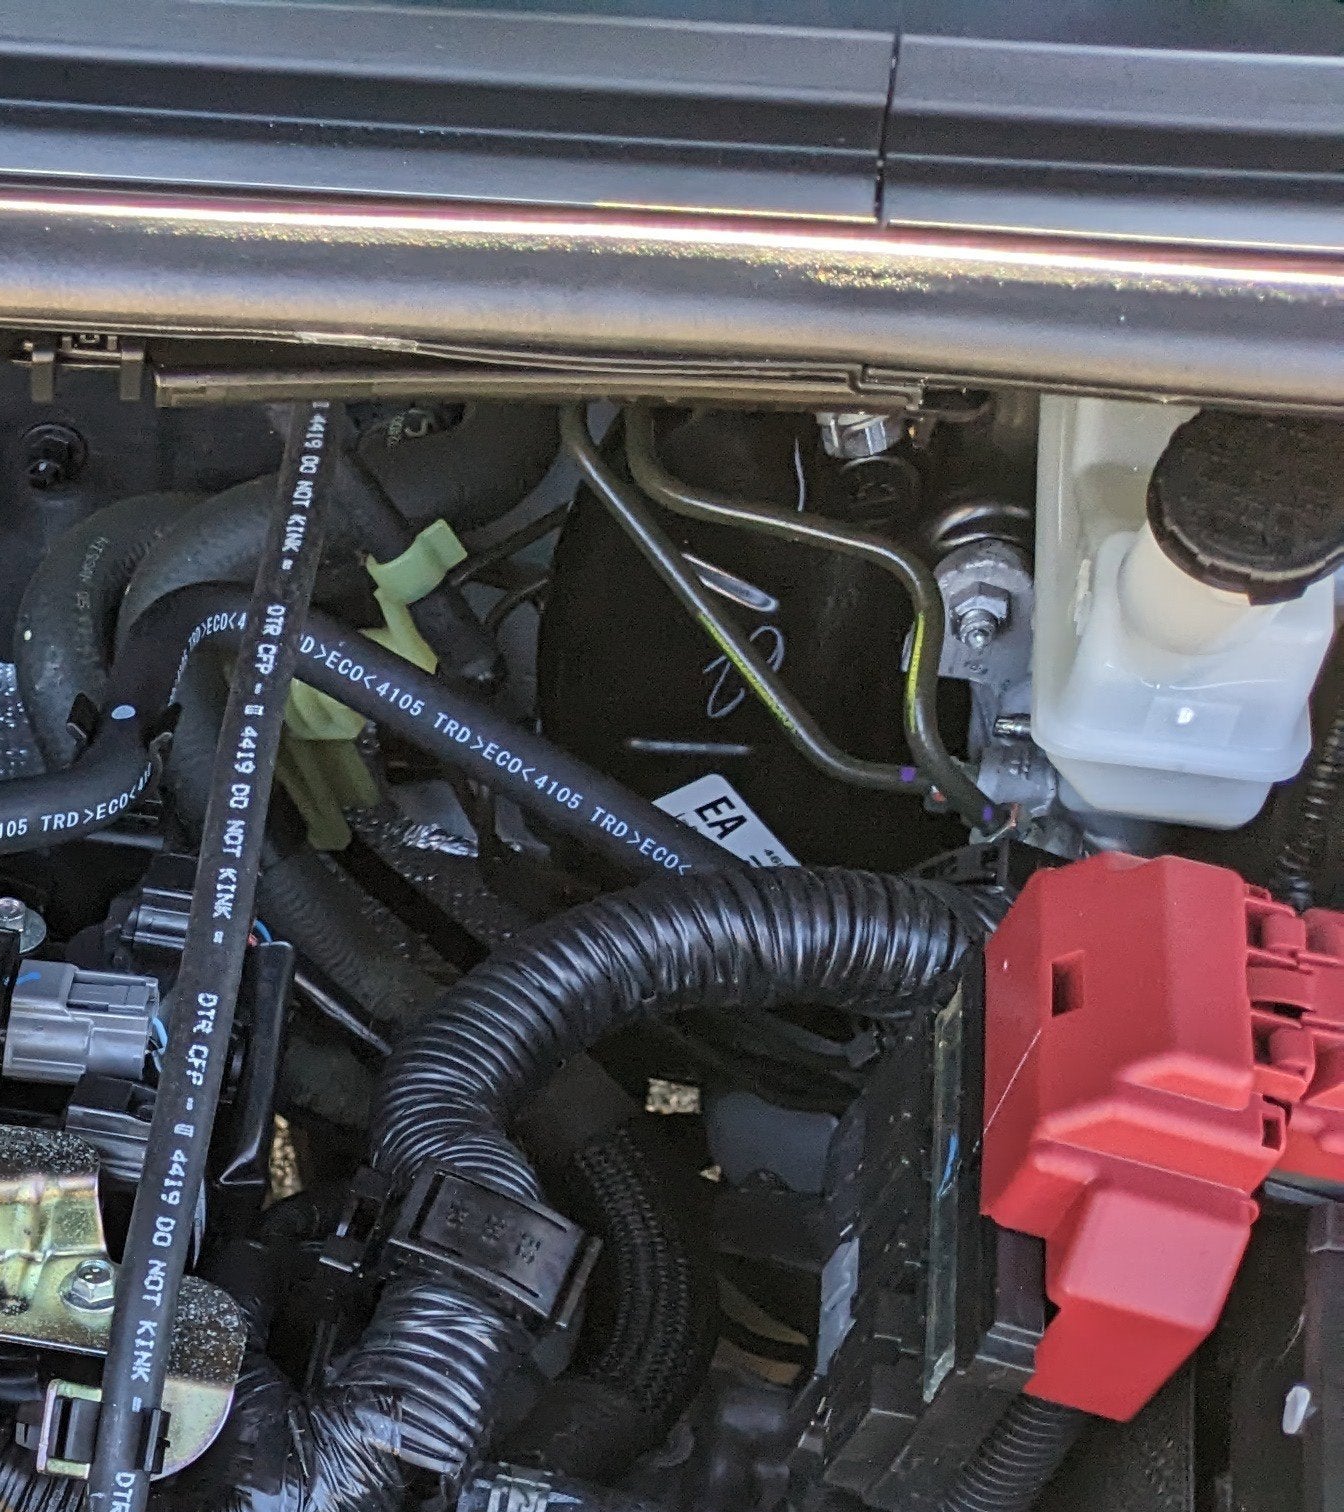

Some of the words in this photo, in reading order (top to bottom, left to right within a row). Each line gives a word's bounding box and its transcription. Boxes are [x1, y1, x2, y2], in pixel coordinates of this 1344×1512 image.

[292, 480, 314, 508] NOT
[282, 514, 307, 553] KINK
[262, 605, 286, 636] DTR
[233, 725, 259, 775] 4419
[229, 782, 251, 811] DO
[694, 796, 747, 840] EA
[222, 819, 246, 859] NOT
[212, 867, 238, 920] KINK
[192, 991, 219, 1035] DTR
[185, 1043, 209, 1087] CFP
[161, 1149, 189, 1206] 4419
[152, 1215, 176, 1248] DO
[142, 1258, 167, 1307] NOT
[130, 1319, 159, 1384] KINK
